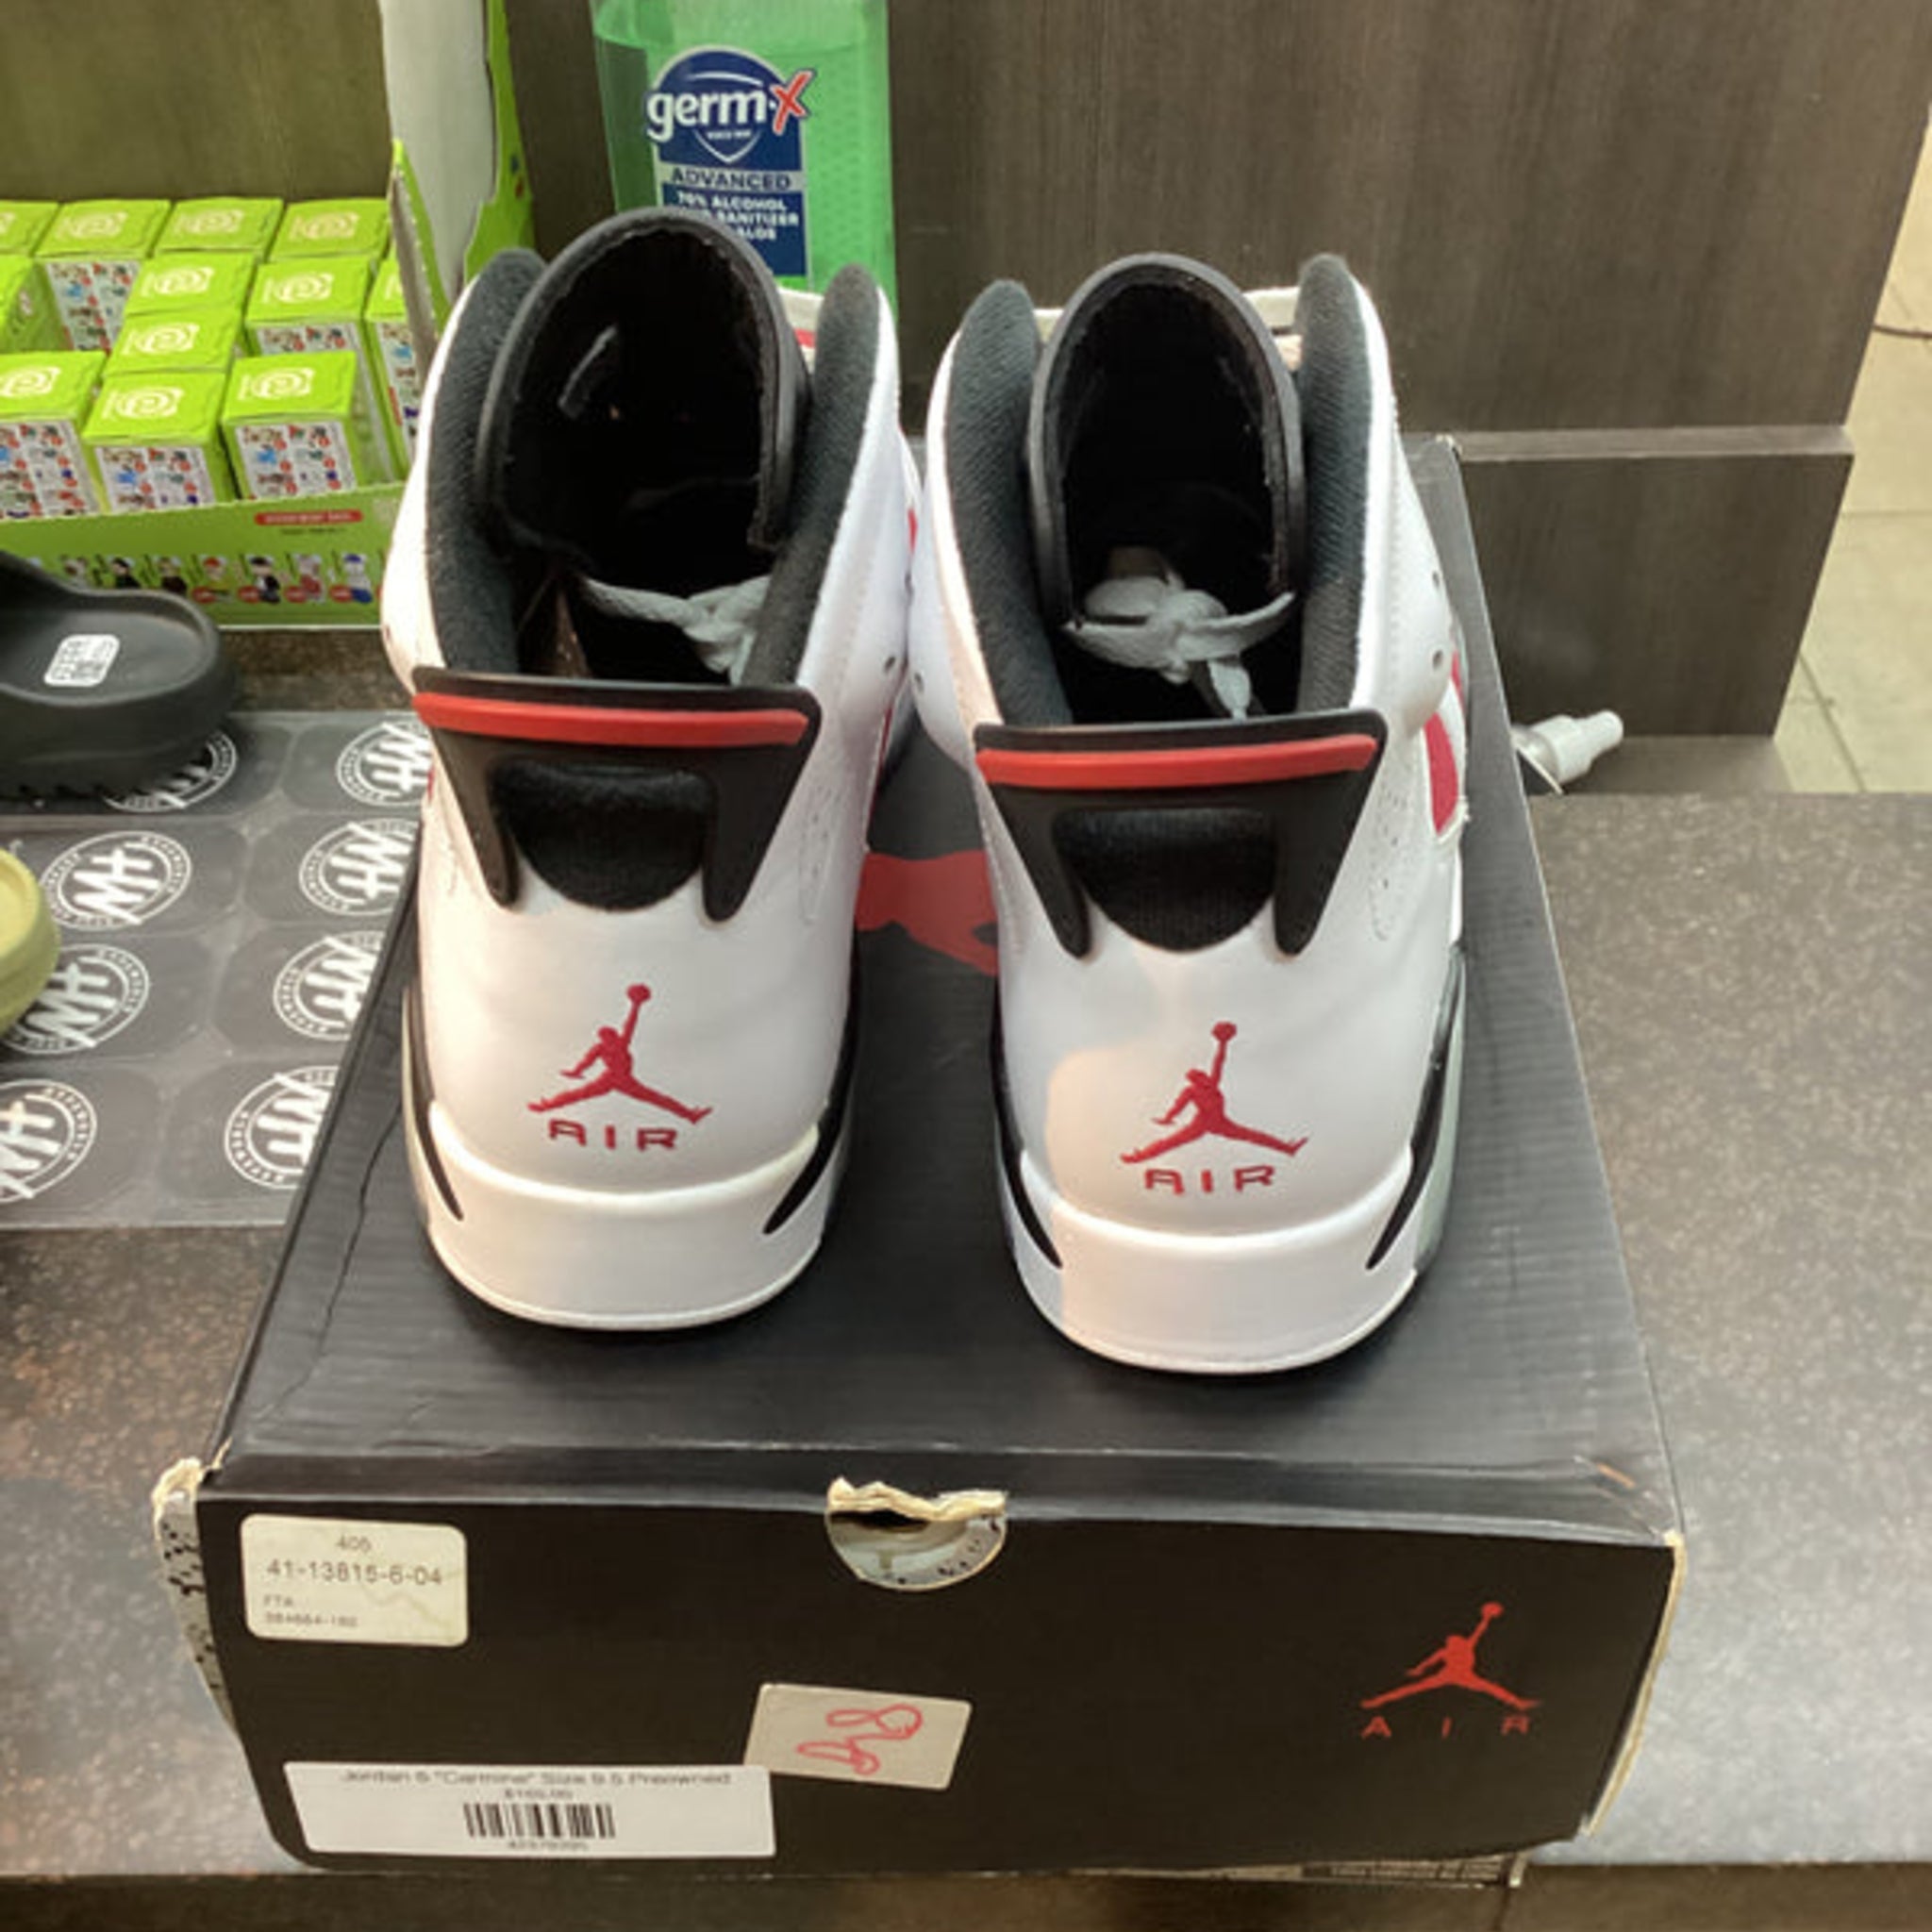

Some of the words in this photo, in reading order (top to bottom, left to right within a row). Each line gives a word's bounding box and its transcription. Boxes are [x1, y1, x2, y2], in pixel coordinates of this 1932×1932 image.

[671, 167, 792, 190] ADVANCED
[711, 194, 787, 211] ALCOHOL
[548, 1118, 679, 1152] AIR
[1143, 1163, 1275, 1196] AIR
[1361, 1715, 1530, 1739] AIR
